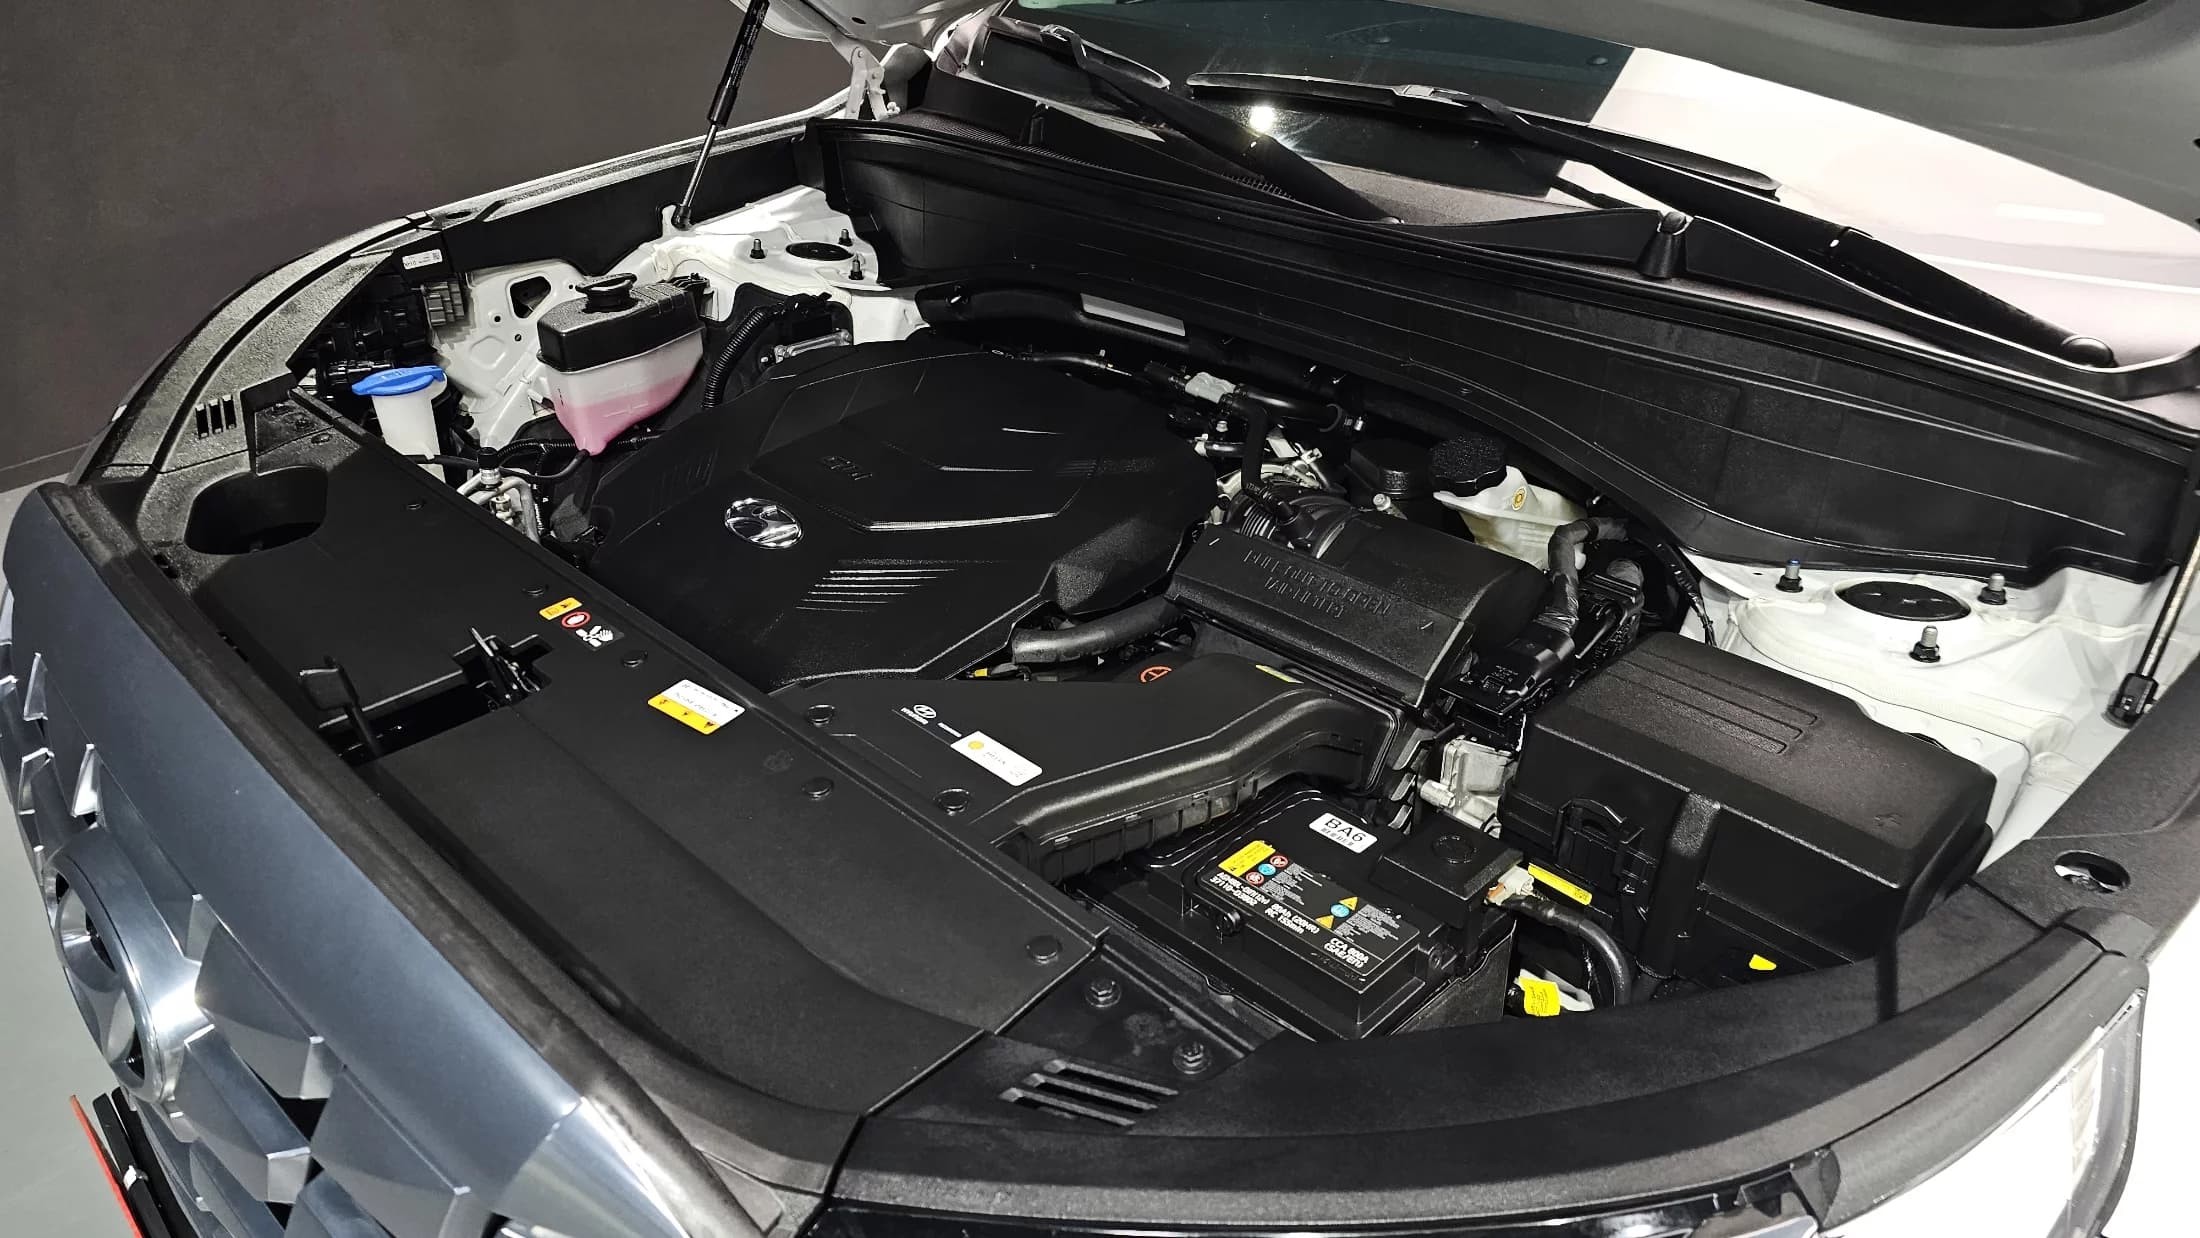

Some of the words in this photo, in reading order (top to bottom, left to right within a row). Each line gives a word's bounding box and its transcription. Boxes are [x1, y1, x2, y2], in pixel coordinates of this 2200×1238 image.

[1325, 818, 1366, 842] BA6
[1265, 908, 1279, 918] RC
[1271, 903, 1292, 918] 80Ah
[1291, 915, 1320, 934] (20HR)
[1330, 938, 1348, 951] CCA
